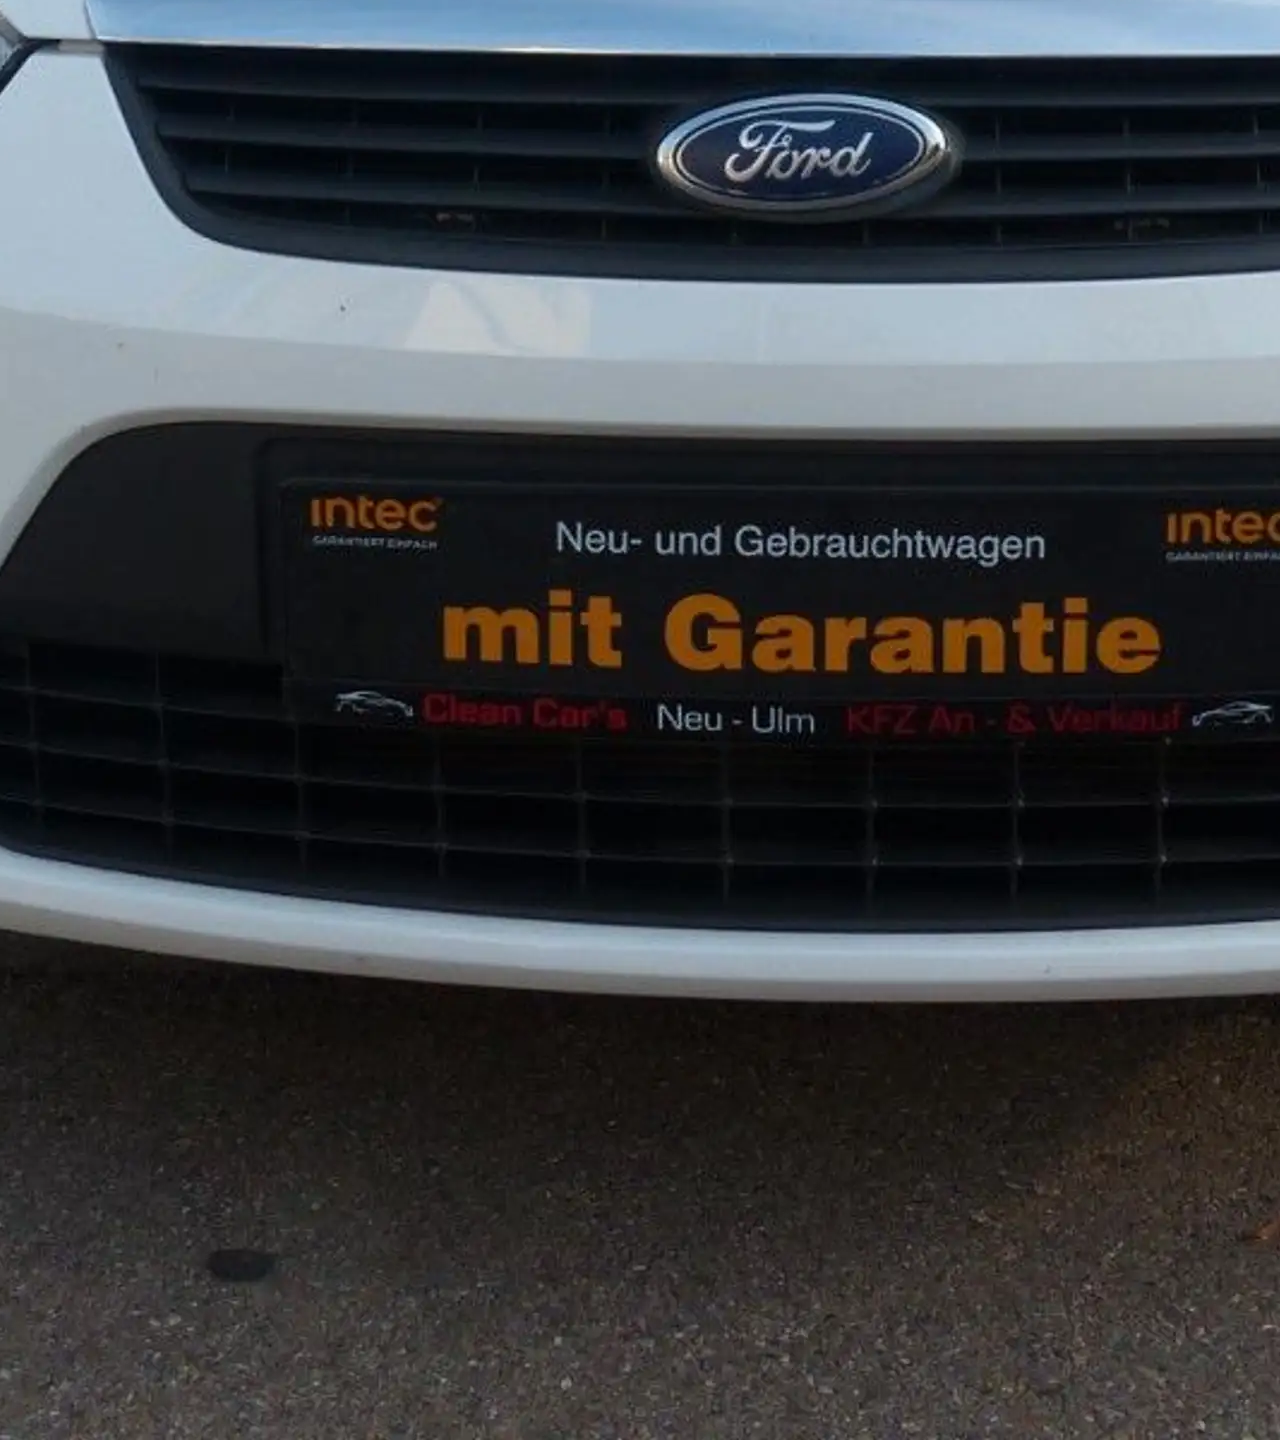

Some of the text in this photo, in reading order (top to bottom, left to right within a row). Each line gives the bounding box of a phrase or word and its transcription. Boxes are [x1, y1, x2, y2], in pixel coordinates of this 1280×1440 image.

[723, 118, 874, 183] Ford
[310, 495, 439, 533] intec
[555, 520, 1046, 568] Neu- und Gebrauchtwagen
[442, 589, 1162, 675] mit Garantie
[421, 692, 522, 726] Clean
[531, 695, 629, 731] Car's
[657, 703, 722, 733] Neu
[751, 704, 816, 735] Ulm
[846, 705, 917, 735] KFZ
[928, 704, 976, 733] An
[1005, 702, 1037, 733] &
[1047, 698, 1184, 733] Verkauf
